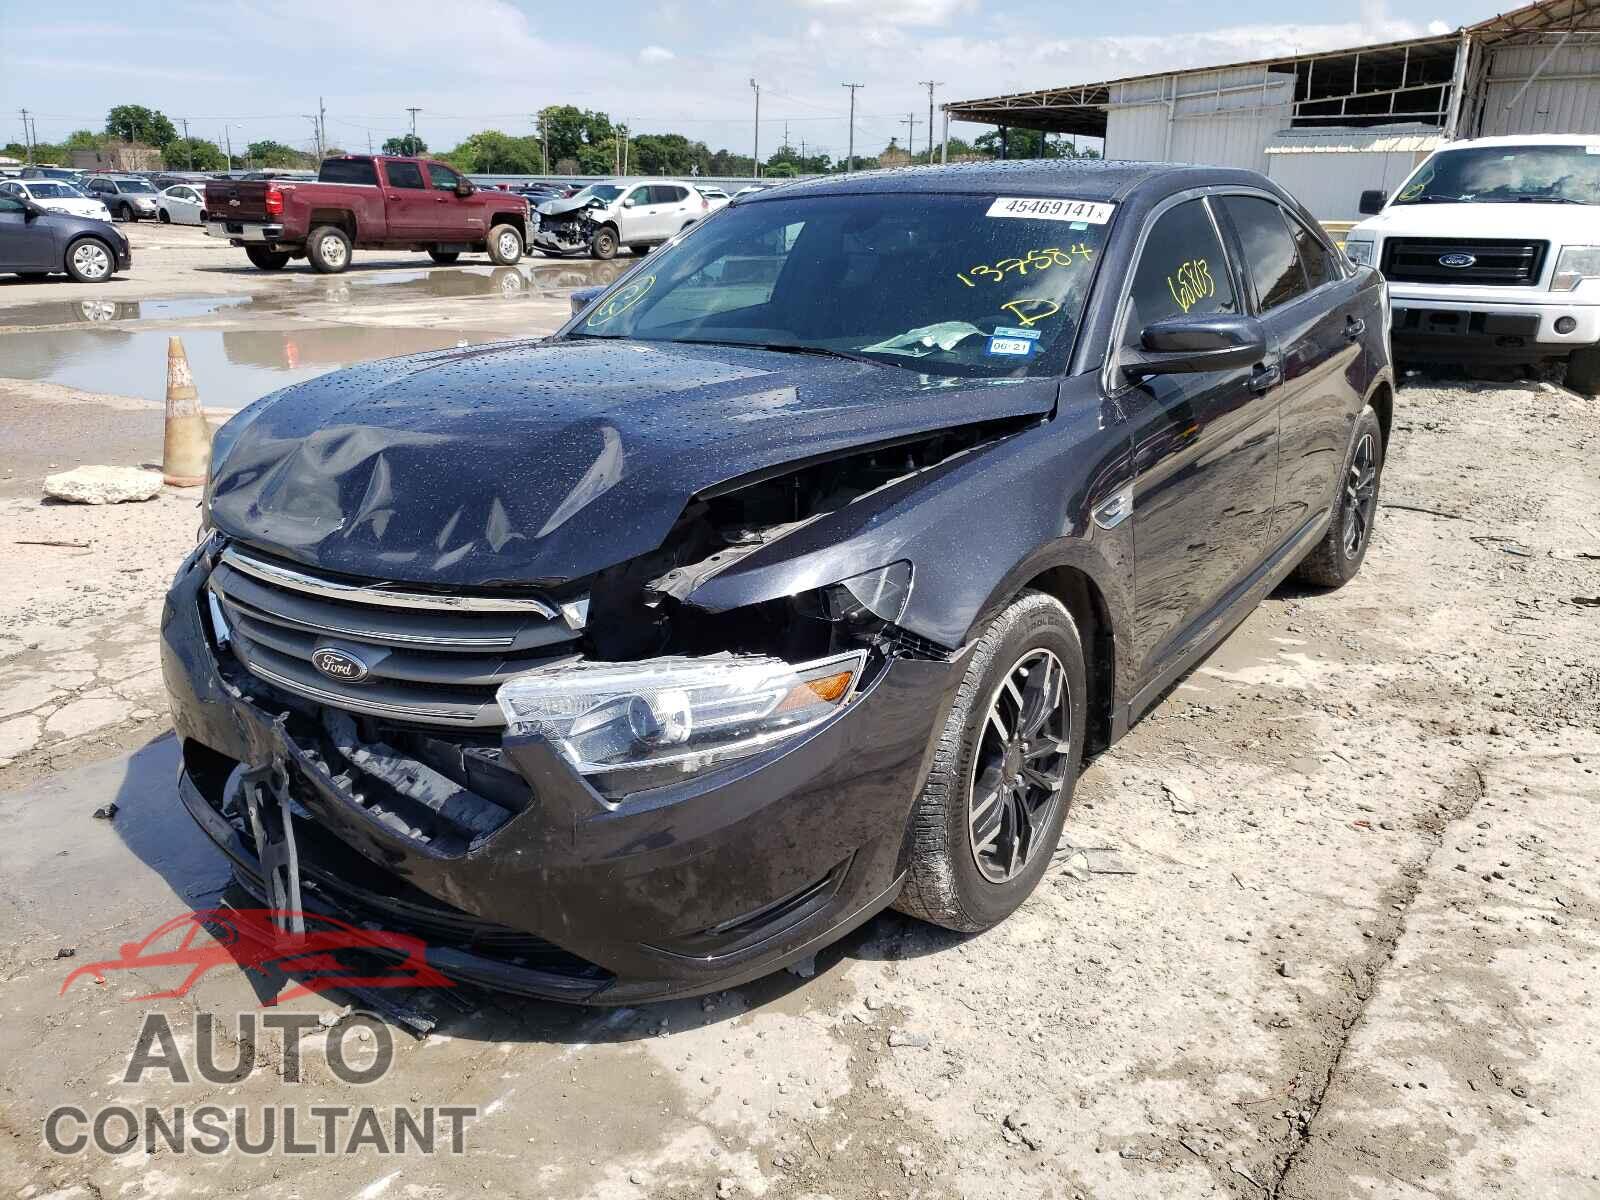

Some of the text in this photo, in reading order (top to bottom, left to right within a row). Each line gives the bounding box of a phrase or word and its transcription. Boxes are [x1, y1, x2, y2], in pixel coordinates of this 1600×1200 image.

[1006, 200, 1095, 217] 45469141
[1000, 299, 1059, 326] D
[322, 654, 352, 676] Ford
